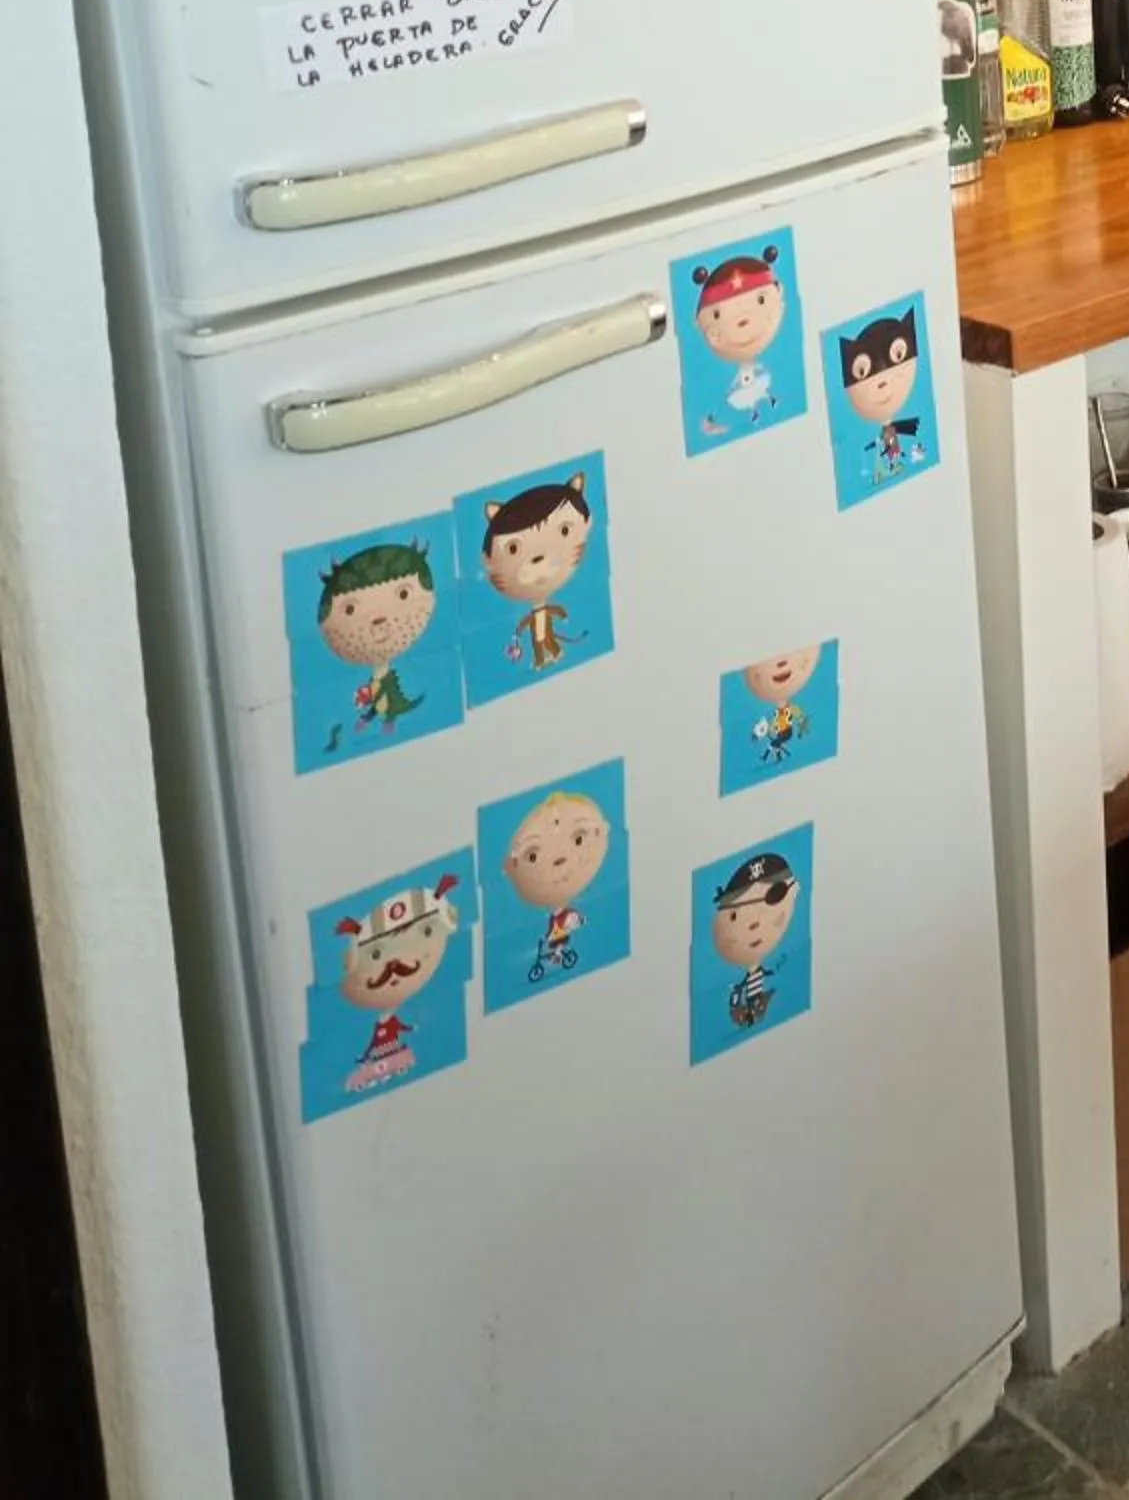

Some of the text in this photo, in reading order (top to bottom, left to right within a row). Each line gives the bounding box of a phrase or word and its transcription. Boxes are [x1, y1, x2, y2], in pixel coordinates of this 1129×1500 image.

[288, 15, 479, 64] LA PUERTA DE
[297, 70, 321, 87] LA
